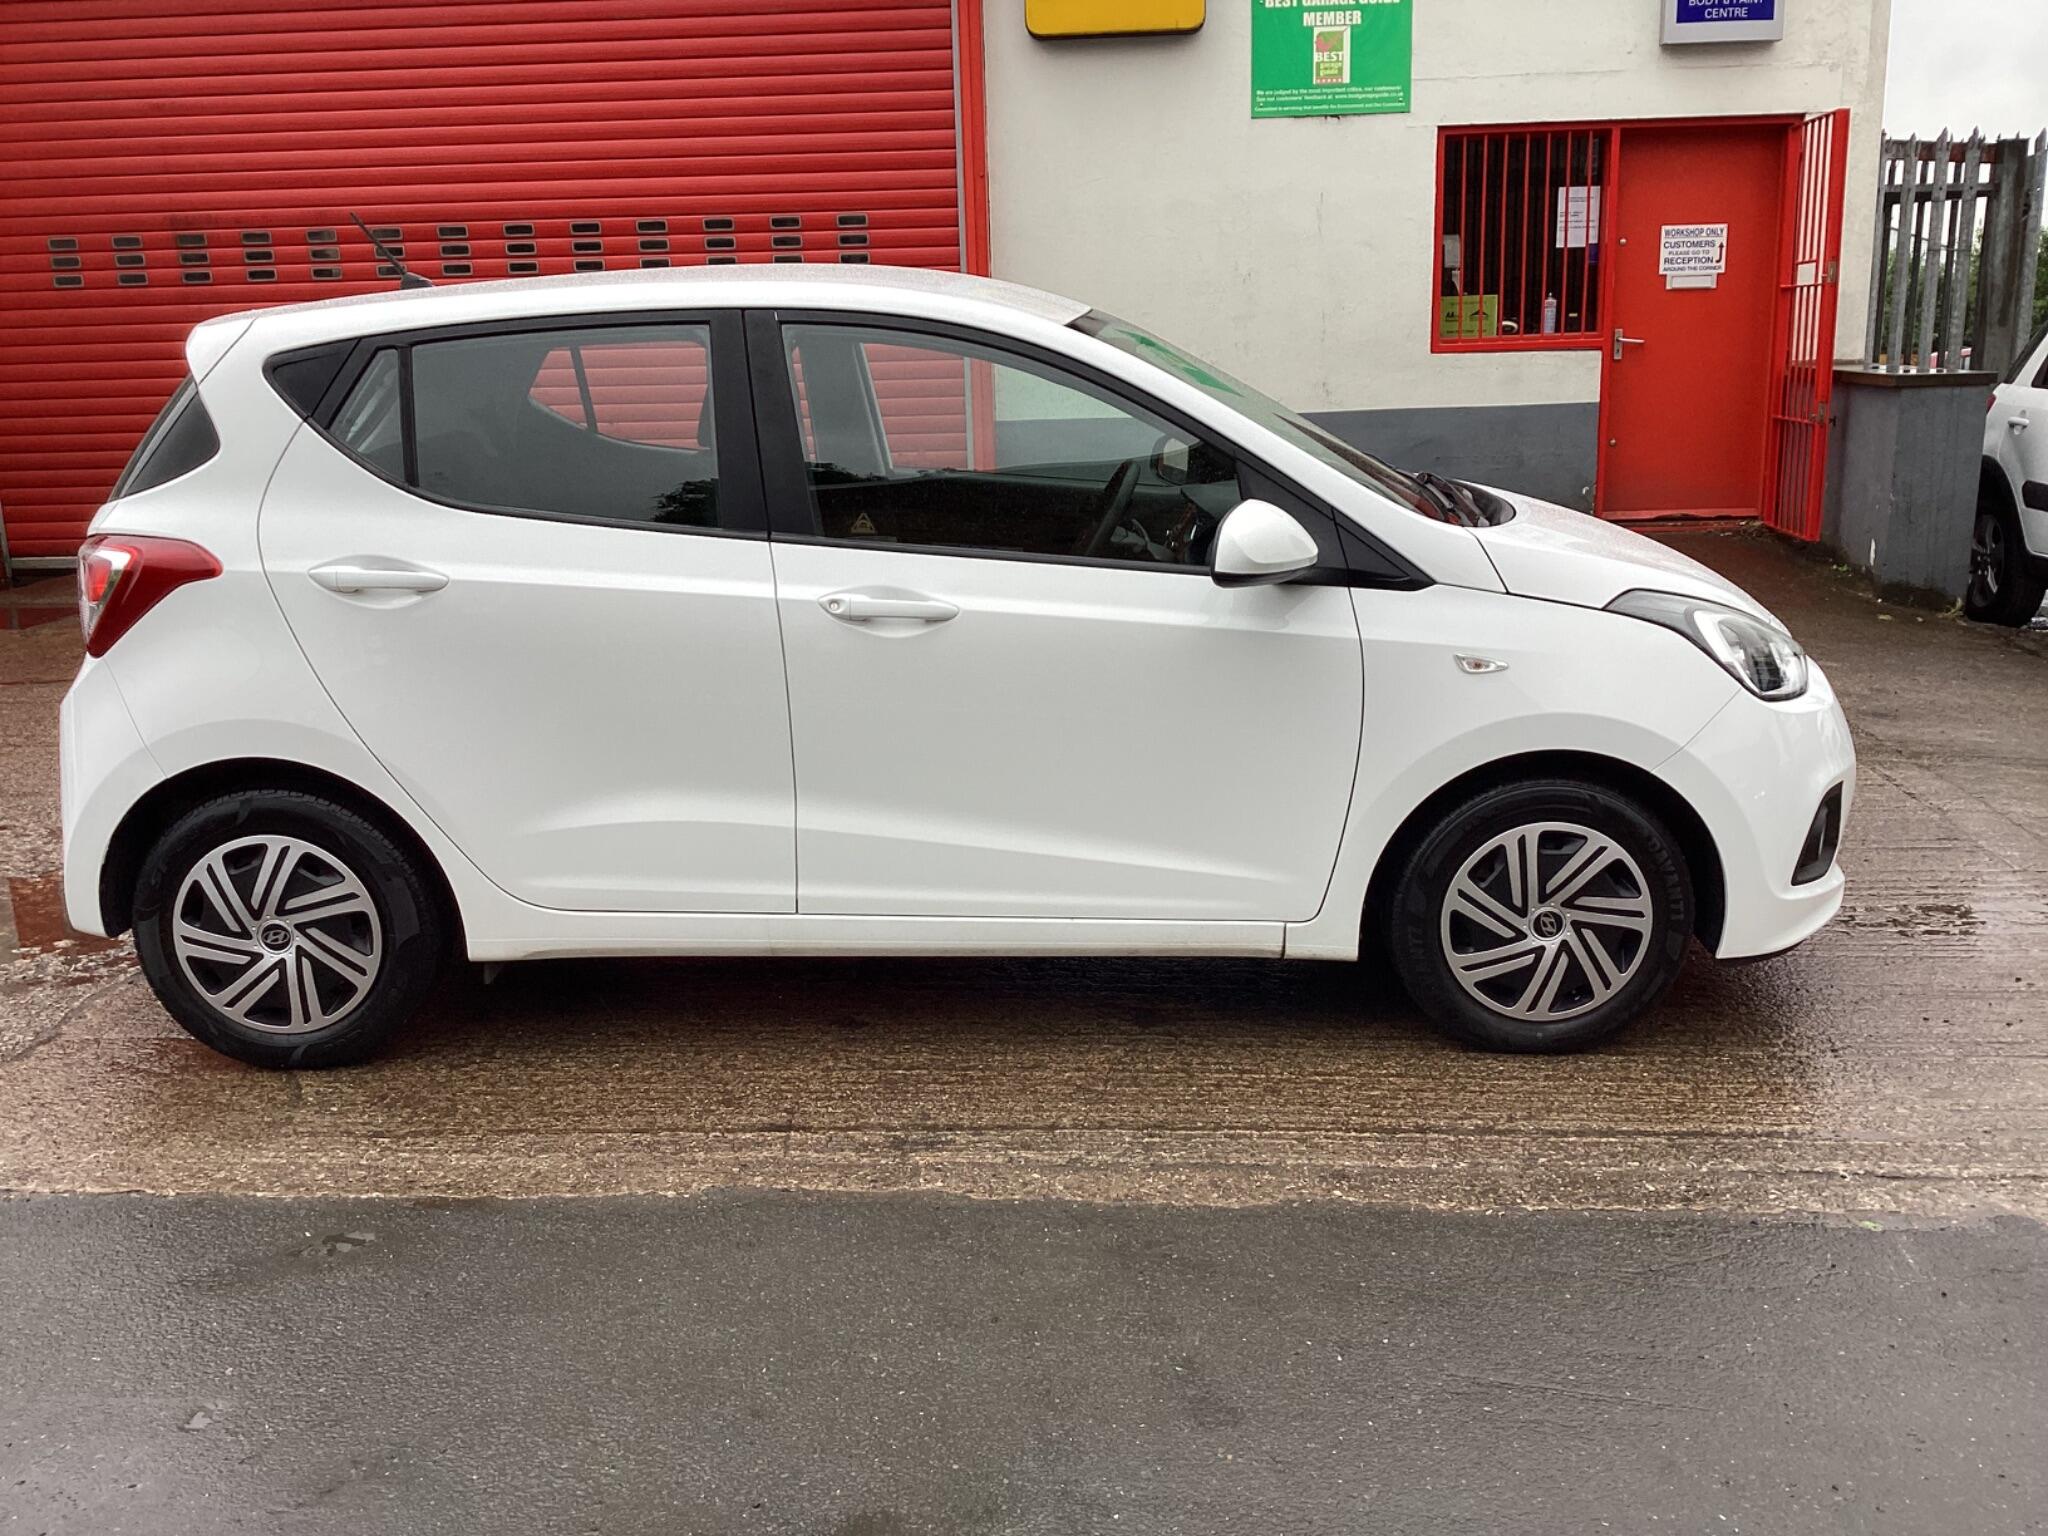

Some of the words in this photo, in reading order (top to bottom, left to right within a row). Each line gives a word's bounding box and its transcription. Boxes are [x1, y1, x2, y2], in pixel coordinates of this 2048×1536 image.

[1303, 10, 1362, 27] MEMBER
[1704, 7, 1749, 19] CENTRE
[1315, 51, 1344, 62] BEST
[1664, 228, 1704, 237] WORKSHOP
[1705, 226, 1725, 236] ONLY
[1663, 239, 1716, 249] CUSTOMERS
[1663, 256, 1714, 265] RECEPTION
